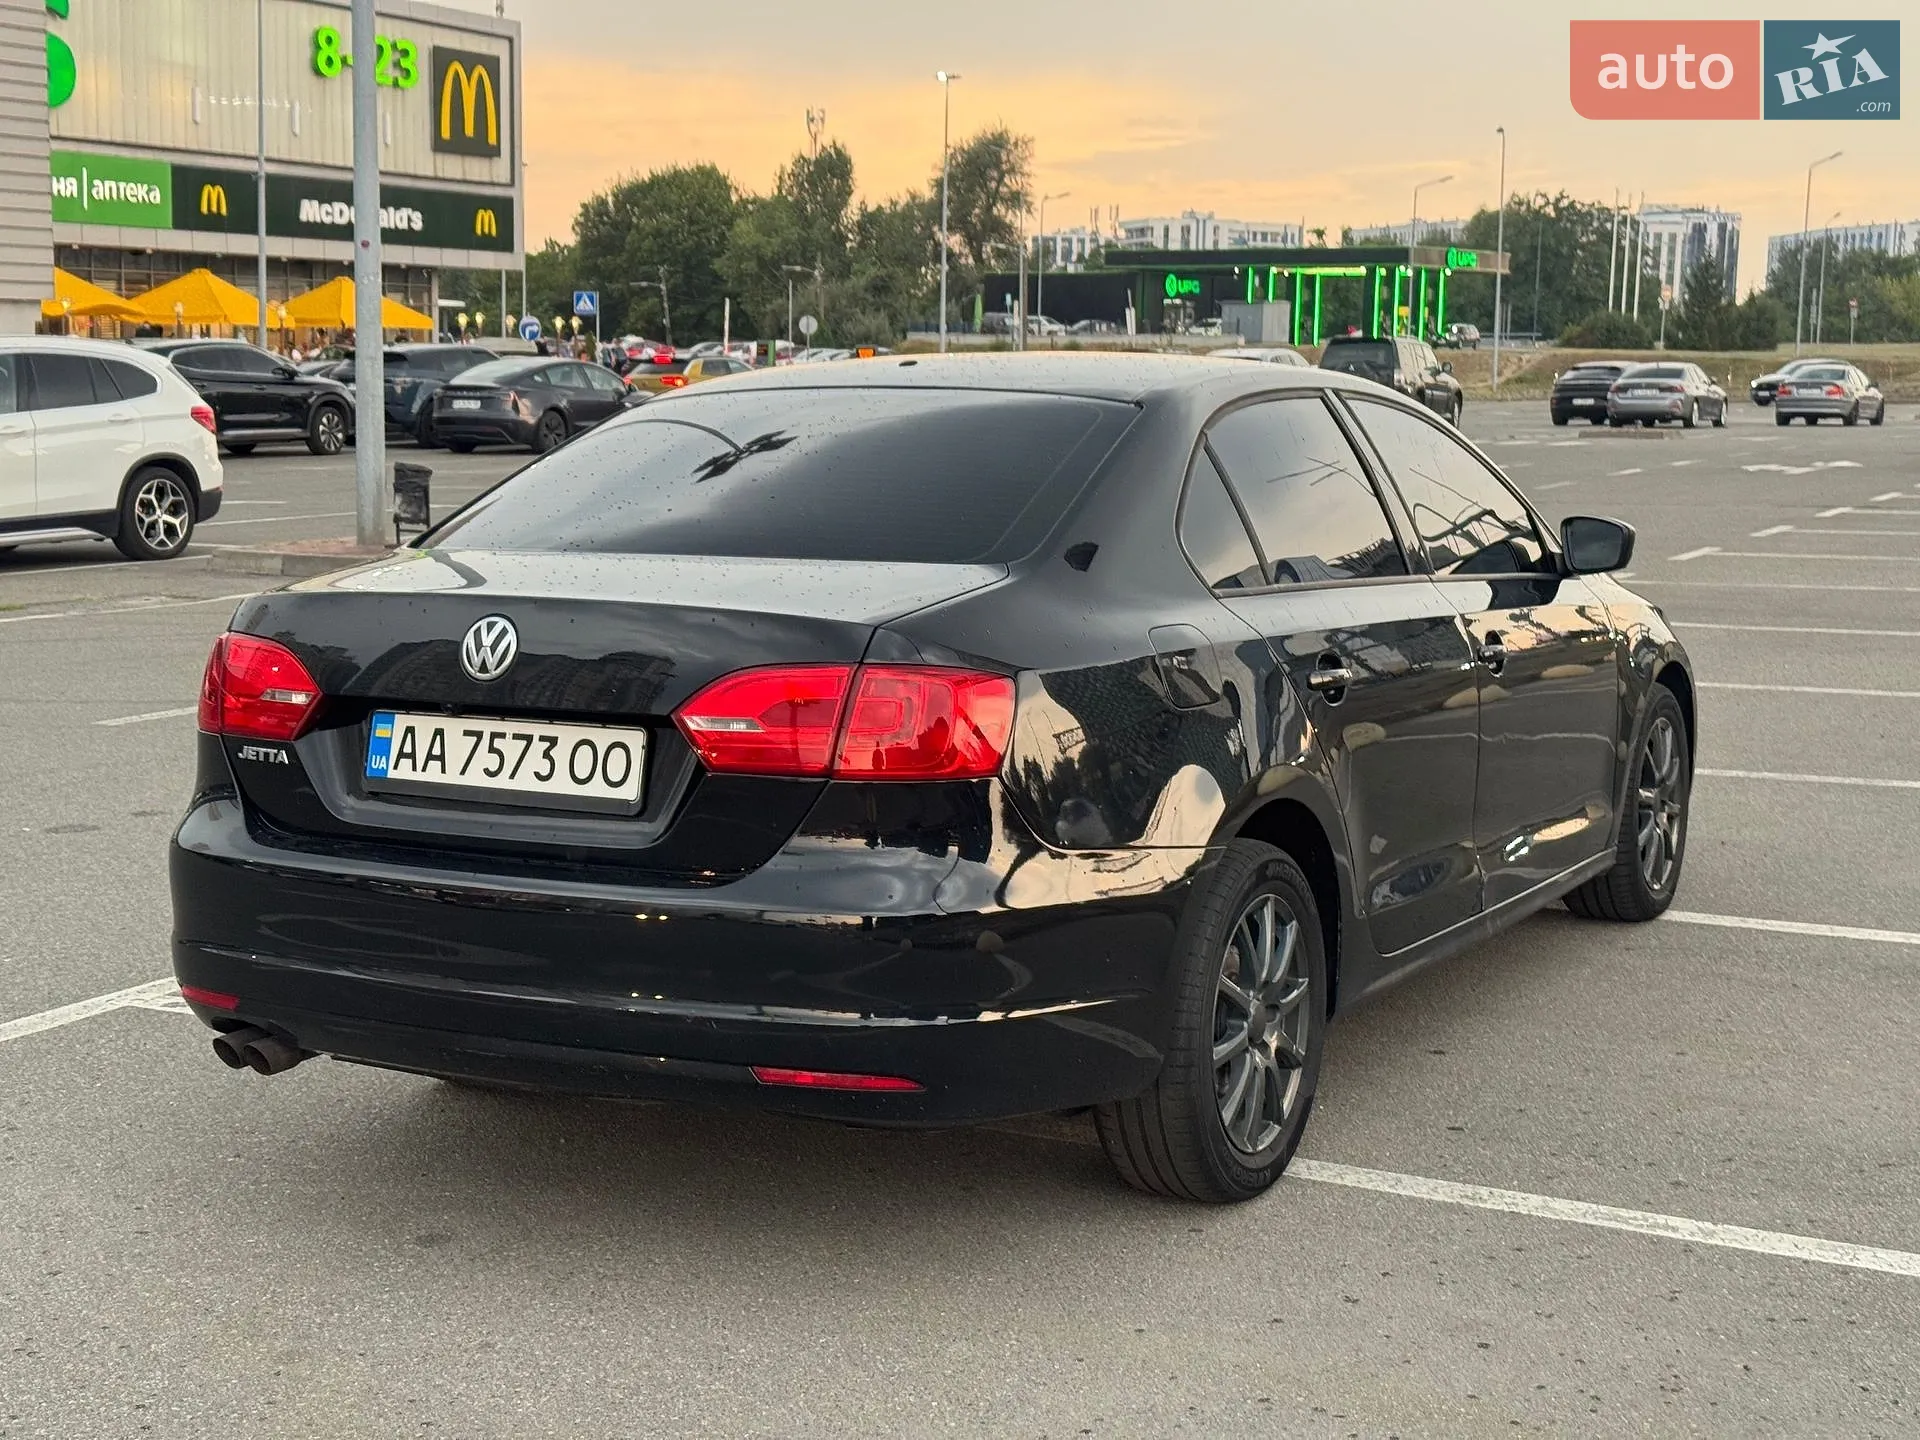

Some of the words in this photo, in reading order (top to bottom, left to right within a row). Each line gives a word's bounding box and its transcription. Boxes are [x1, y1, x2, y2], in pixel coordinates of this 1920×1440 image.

[91, 178, 161, 205] аптека
[299, 198, 424, 232] McDald's
[237, 745, 289, 765] JETTA
[371, 754, 388, 770] UA
[392, 725, 447, 775] AA
[459, 729, 559, 783] 7573
